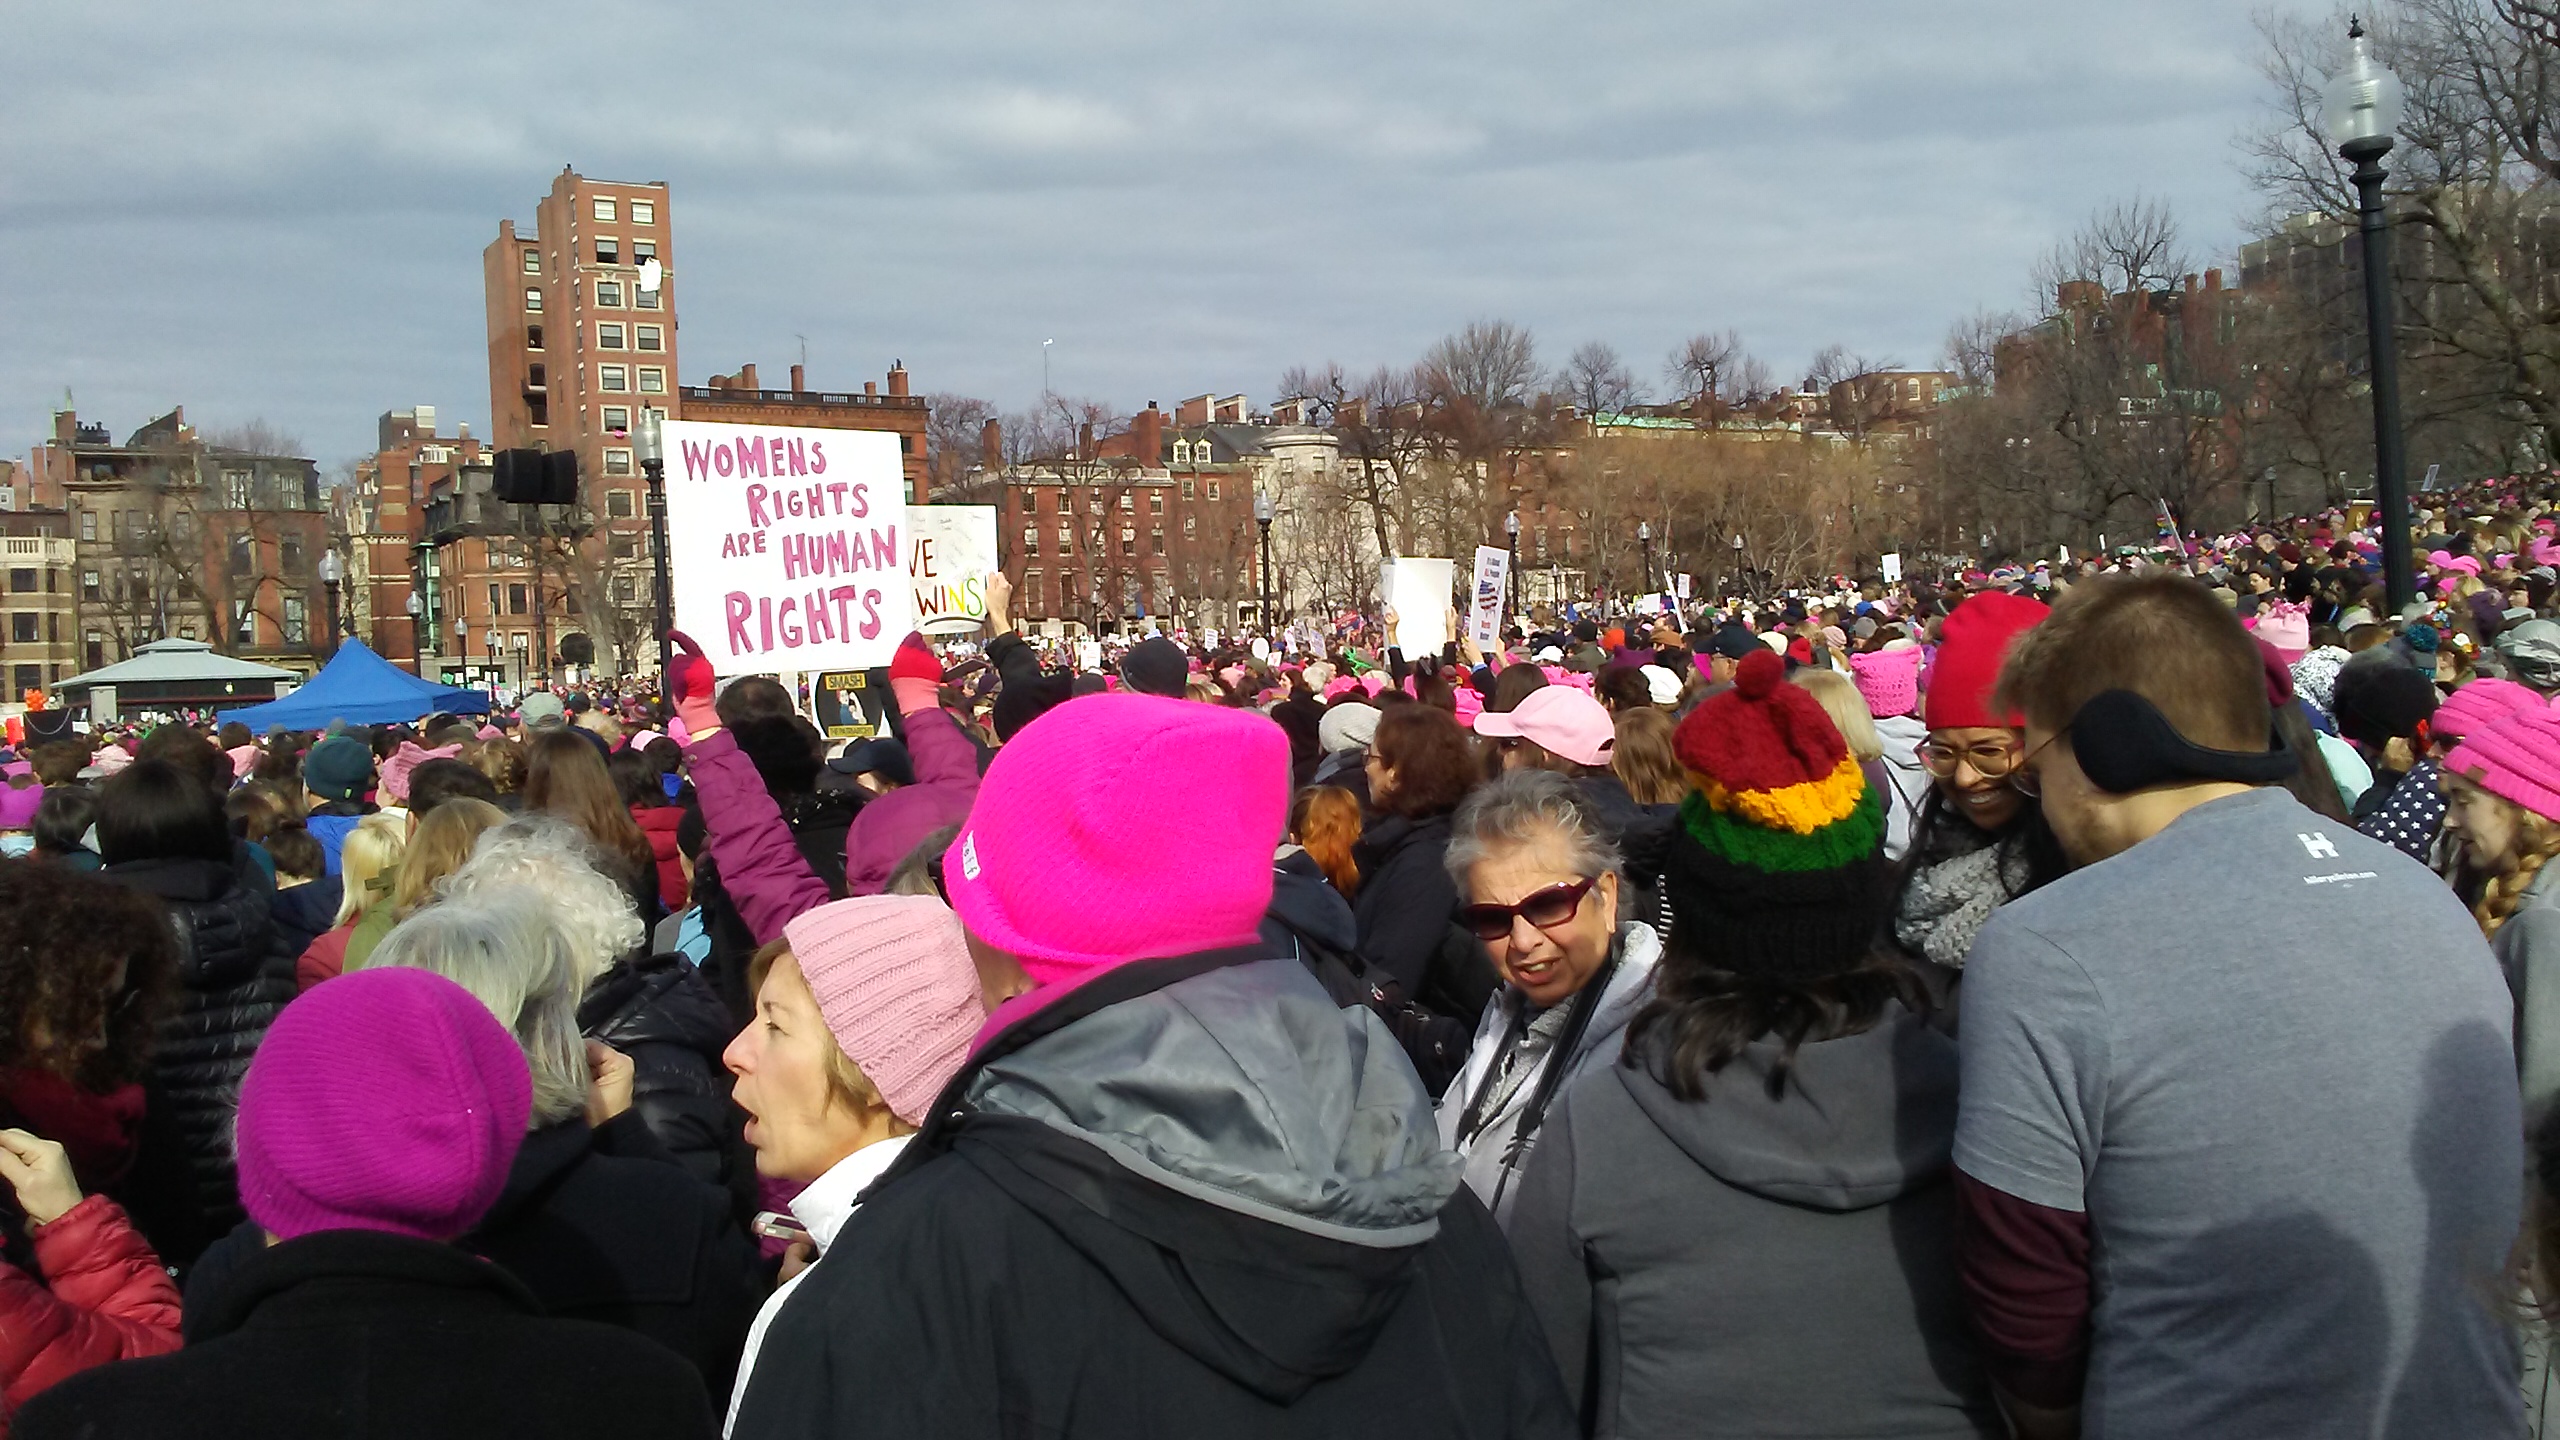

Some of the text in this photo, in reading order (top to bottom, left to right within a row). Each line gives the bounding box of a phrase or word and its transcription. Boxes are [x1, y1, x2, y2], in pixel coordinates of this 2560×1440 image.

[682, 436, 827, 482] WOMENS
[746, 482, 869, 528] RIGHTS
[722, 525, 897, 580] ARE HUMAN
[725, 585, 882, 656] RIGHTS
[828, 674, 863, 688] SMASH
